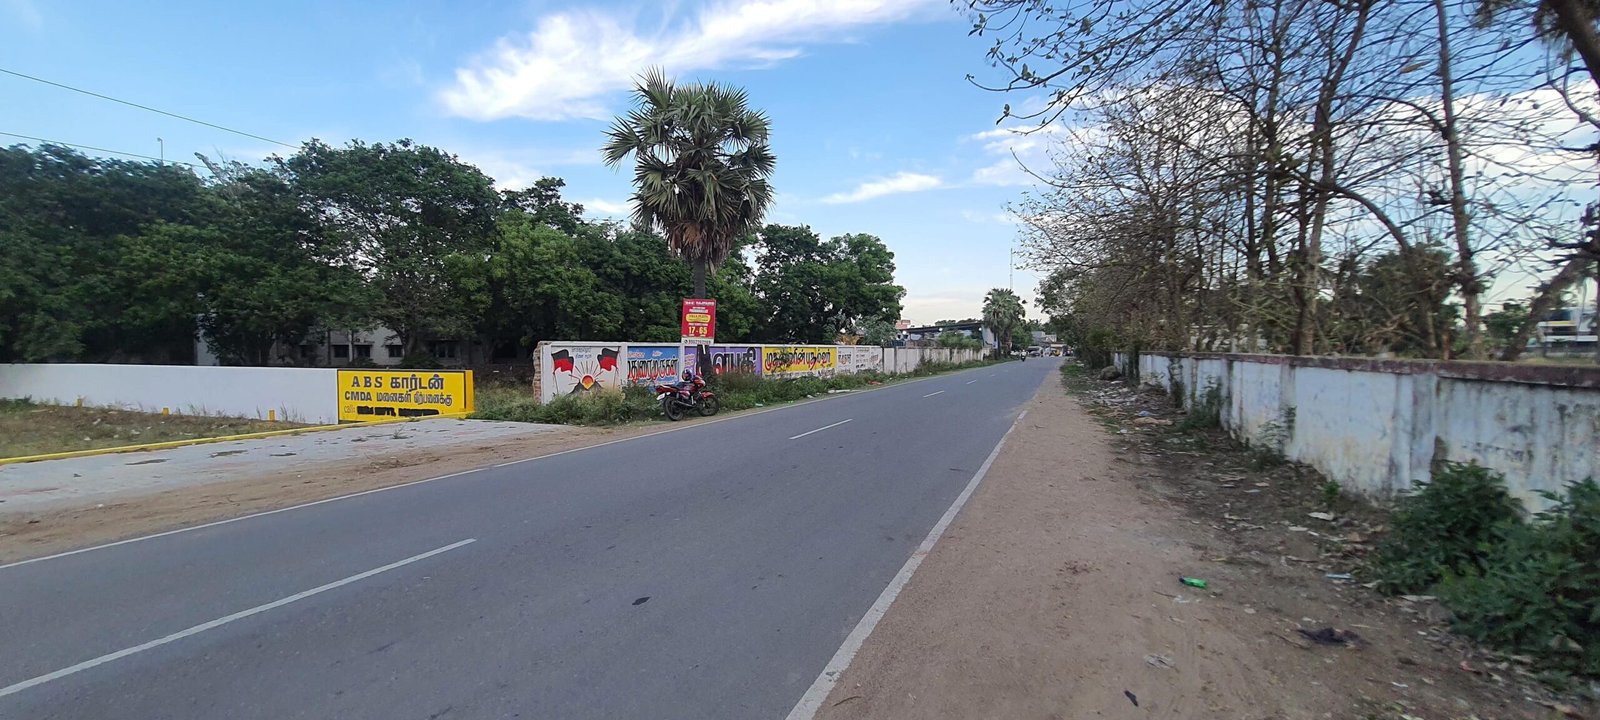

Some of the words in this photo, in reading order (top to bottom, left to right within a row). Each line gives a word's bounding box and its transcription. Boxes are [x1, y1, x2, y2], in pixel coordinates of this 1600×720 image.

[688, 326, 695, 334] 17
[390, 373, 445, 392] கார்டன்
[344, 391, 372, 402] CMDA
